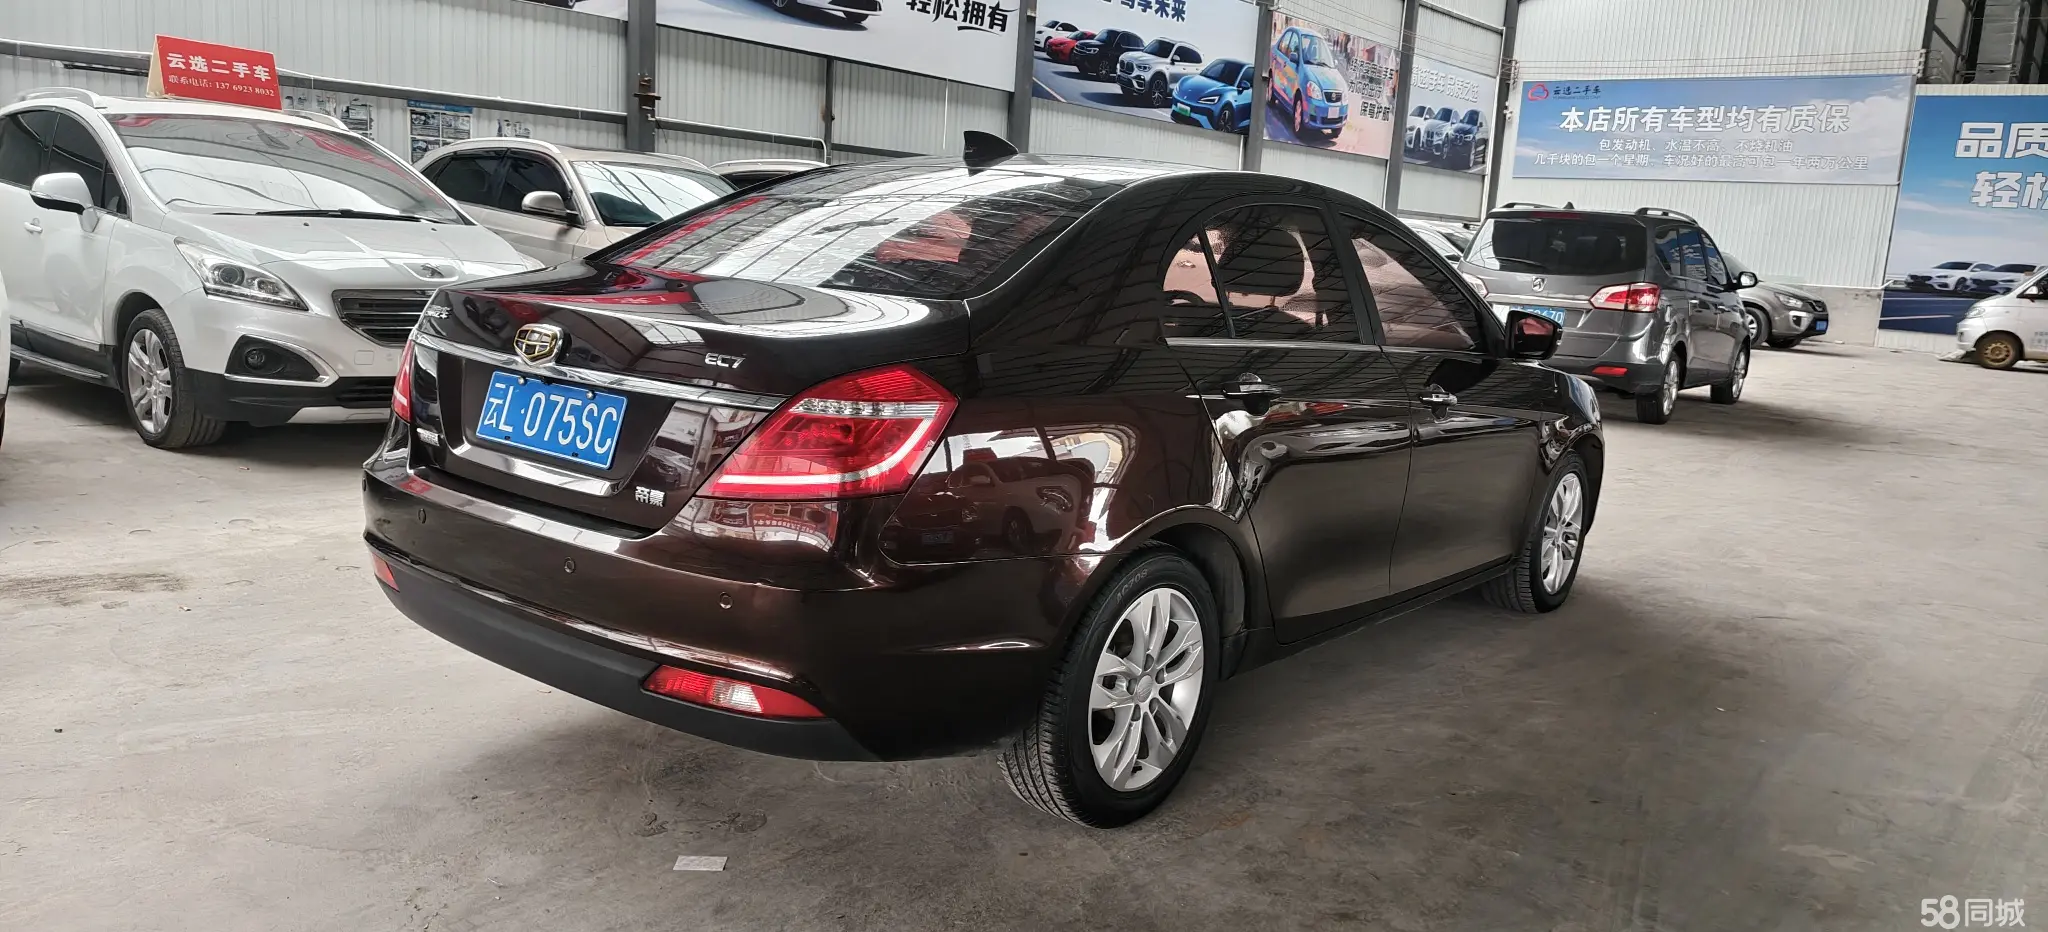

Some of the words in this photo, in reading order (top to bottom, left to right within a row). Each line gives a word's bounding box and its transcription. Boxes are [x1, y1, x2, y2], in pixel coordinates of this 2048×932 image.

[166, 52, 272, 82] 云选二手车
[215, 81, 230, 90] 137
[233, 84, 253, 94] 6923
[254, 86, 275, 97] 8032
[1552, 85, 1602, 96] 云选二手车
[1559, 104, 1850, 134] 本店所有车型均有质保
[1954, 121, 2048, 159] 品质
[704, 352, 746, 369] EC7
